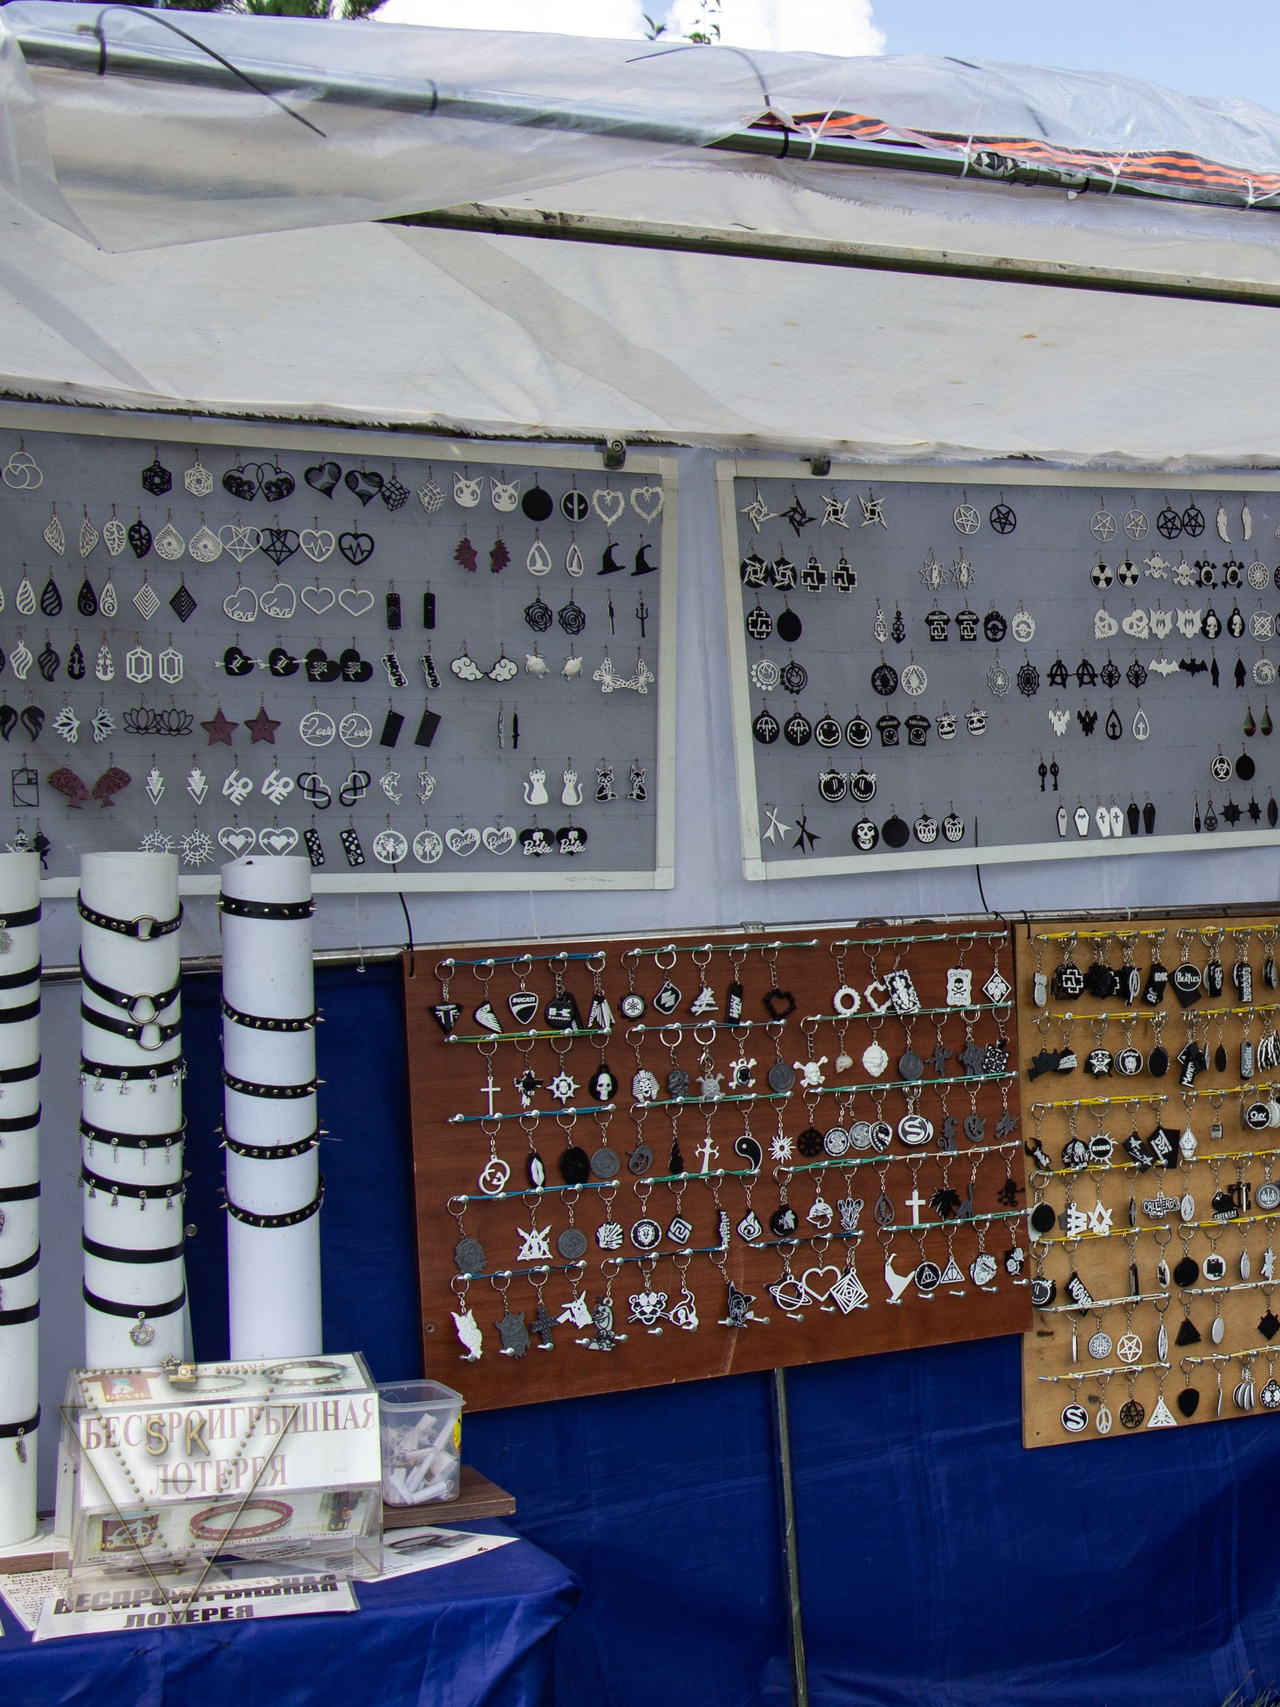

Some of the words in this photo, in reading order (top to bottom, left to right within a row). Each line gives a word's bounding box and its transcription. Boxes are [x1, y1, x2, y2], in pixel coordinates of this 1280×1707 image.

[879, 719, 898, 728] NIRVANA
[909, 719, 928, 727] NIRVANA
[523, 839, 552, 855] Barbie
[560, 838, 586, 854] Barbie
[1244, 1047, 1252, 1069] Gorillaz
[85, 1397, 375, 1451] БЕСПРОИГРЫШНАЯ
[150, 1454, 288, 1496] ЛОТЕРЕЯ
[123, 1604, 254, 1629] ЛОТЕРЕЯ
